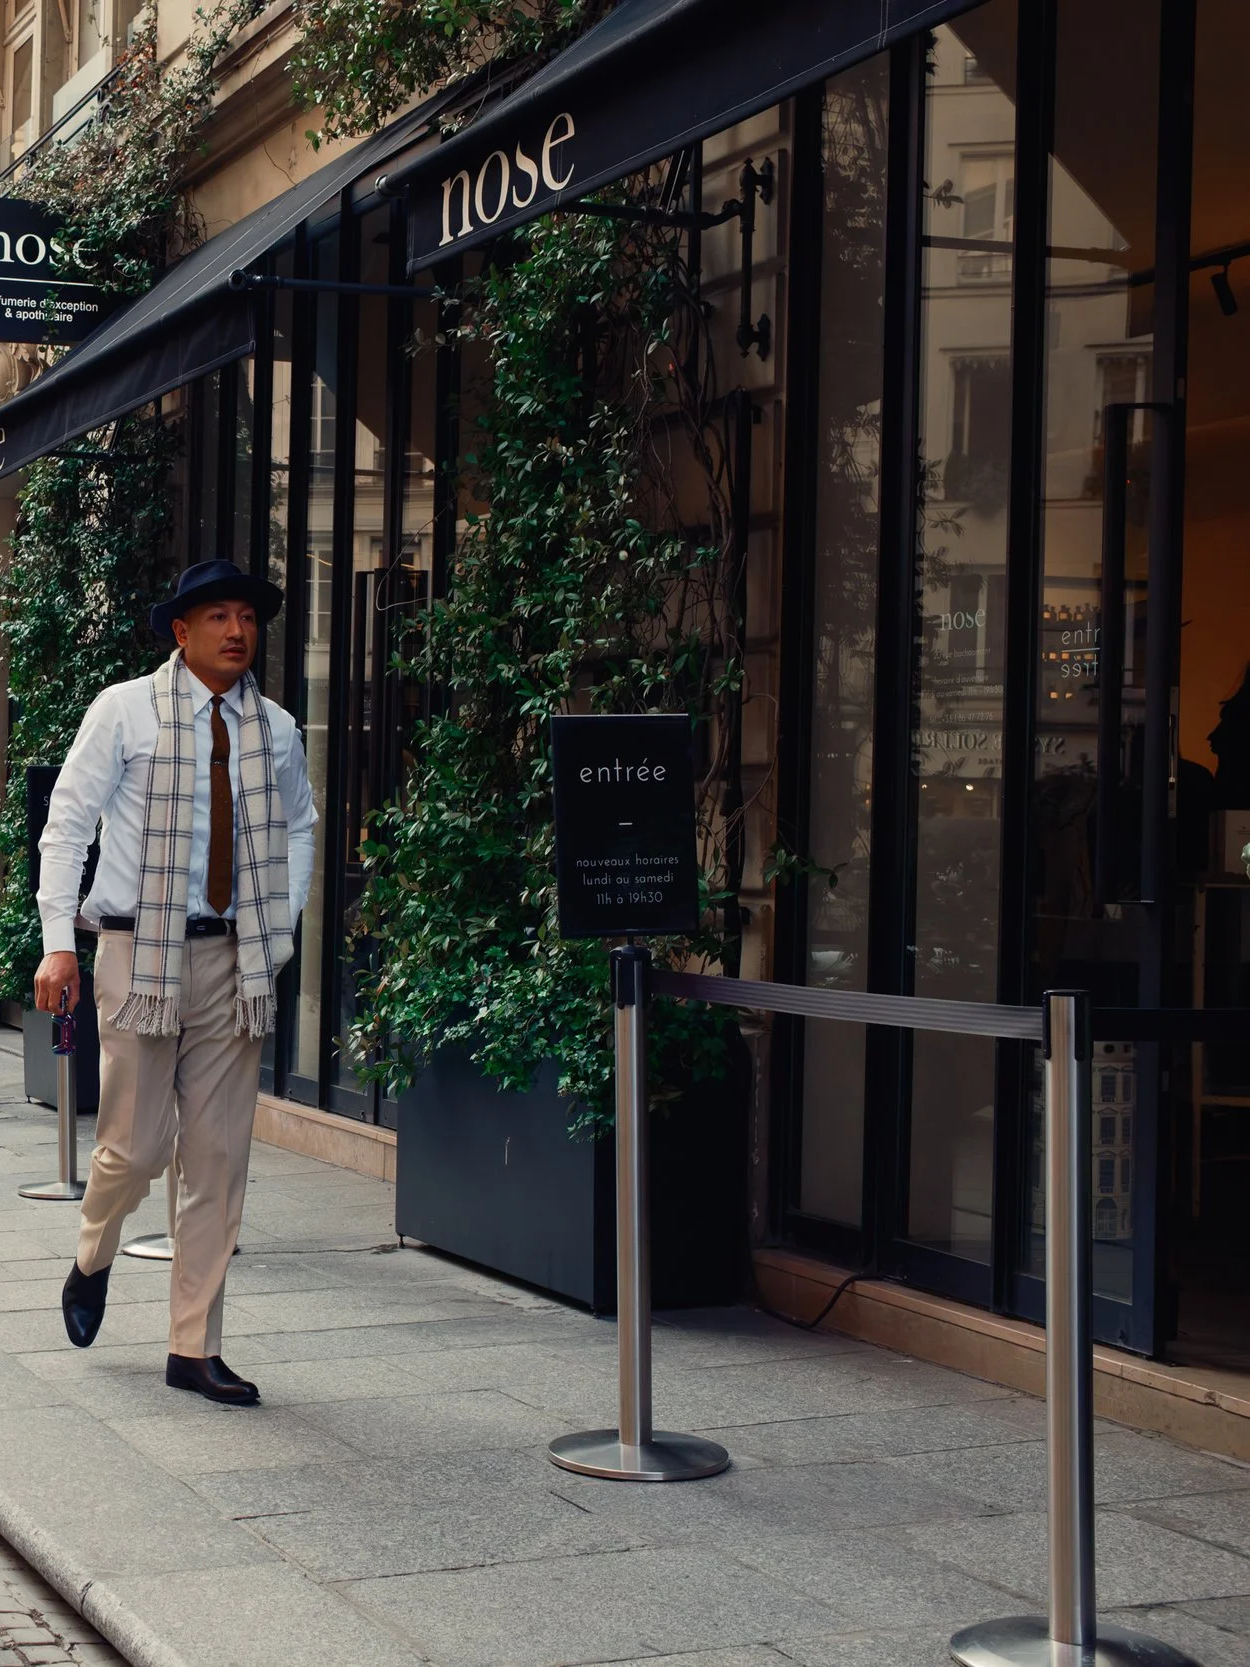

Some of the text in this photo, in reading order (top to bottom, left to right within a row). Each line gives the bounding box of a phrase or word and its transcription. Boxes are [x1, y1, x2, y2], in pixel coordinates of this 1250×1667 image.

[439, 112, 575, 247] nose
[4, 308, 13, 318] &
[940, 608, 985, 631] nose
[1061, 621, 1101, 645] entr
[579, 757, 666, 783] entrée
[576, 853, 679, 868] nouveaux horaires
[582, 870, 674, 885] lundi au samedi
[596, 891, 663, 905] 11h à 19h30
